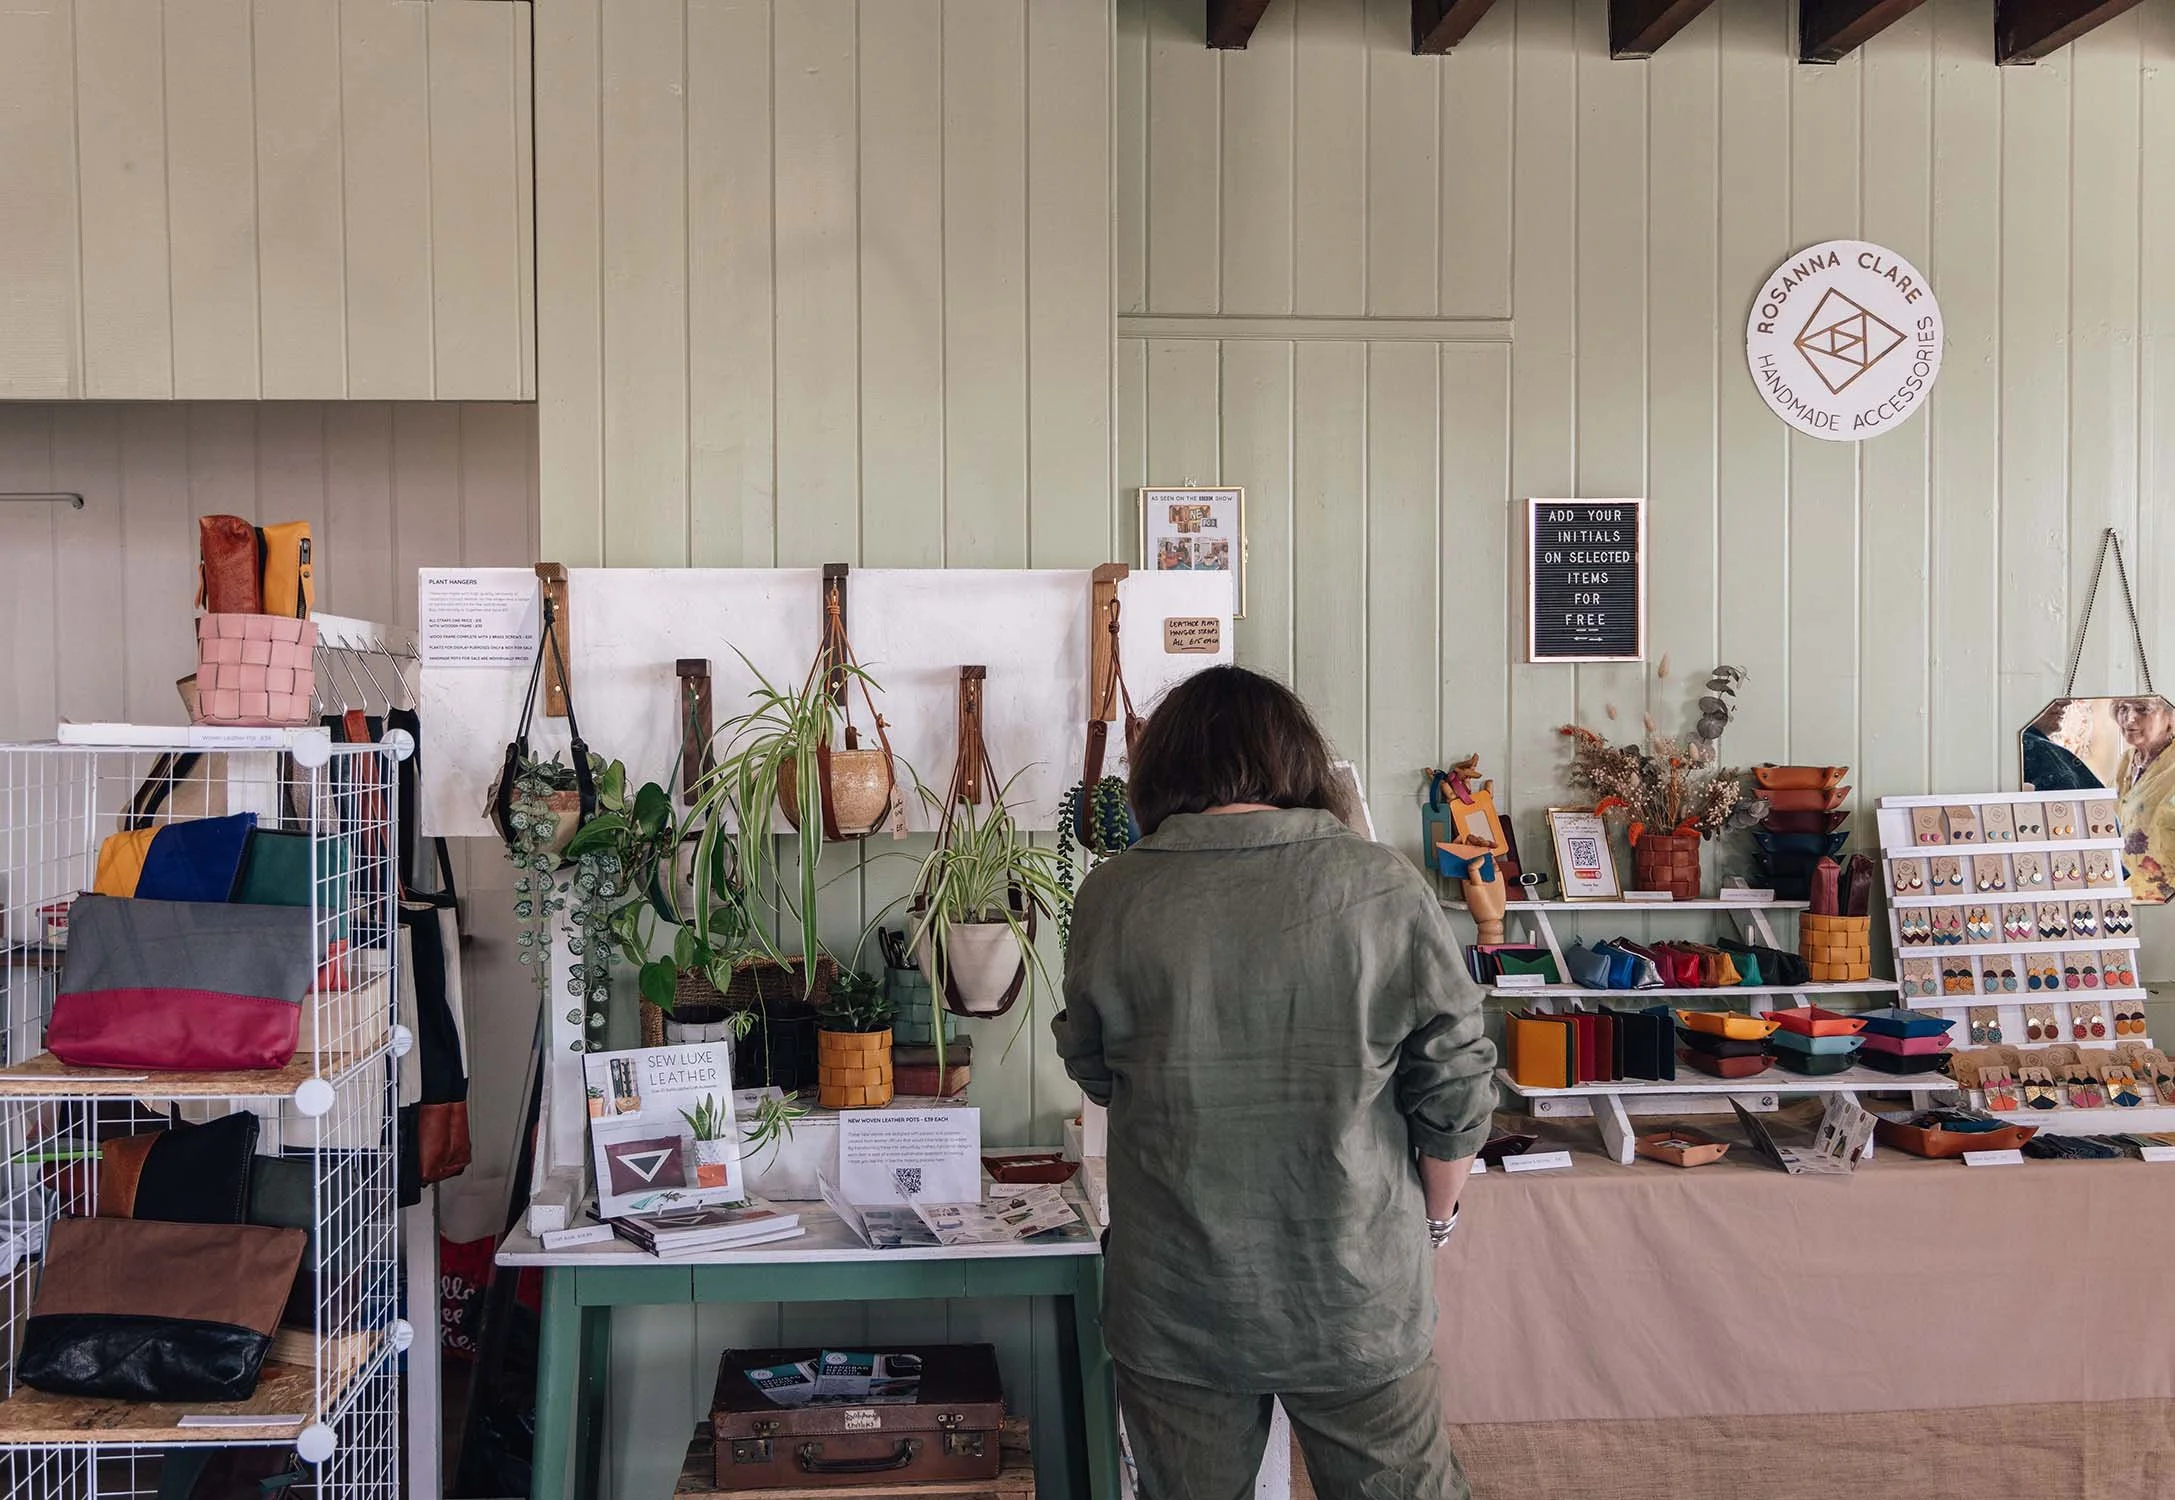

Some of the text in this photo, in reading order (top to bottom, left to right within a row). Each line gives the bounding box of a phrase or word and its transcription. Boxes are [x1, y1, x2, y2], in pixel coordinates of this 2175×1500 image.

[1757, 251, 1922, 334] ROSANNA CLARE
[1758, 315, 1935, 431] HANDMADE ACCESSORIES
[1549, 510, 1622, 521] ADD YOUR
[1558, 530, 1621, 542] INITIALS
[1544, 551, 1630, 563] ON SELECTED
[1568, 572, 1608, 584] ITEMS
[1574, 593, 1600, 605] FOR
[1565, 614, 1605, 625] FREE
[1172, 638, 1184, 646] ALL
[648, 1051, 713, 1068] SEW LUXE
[650, 1068, 717, 1086] LEATHER
